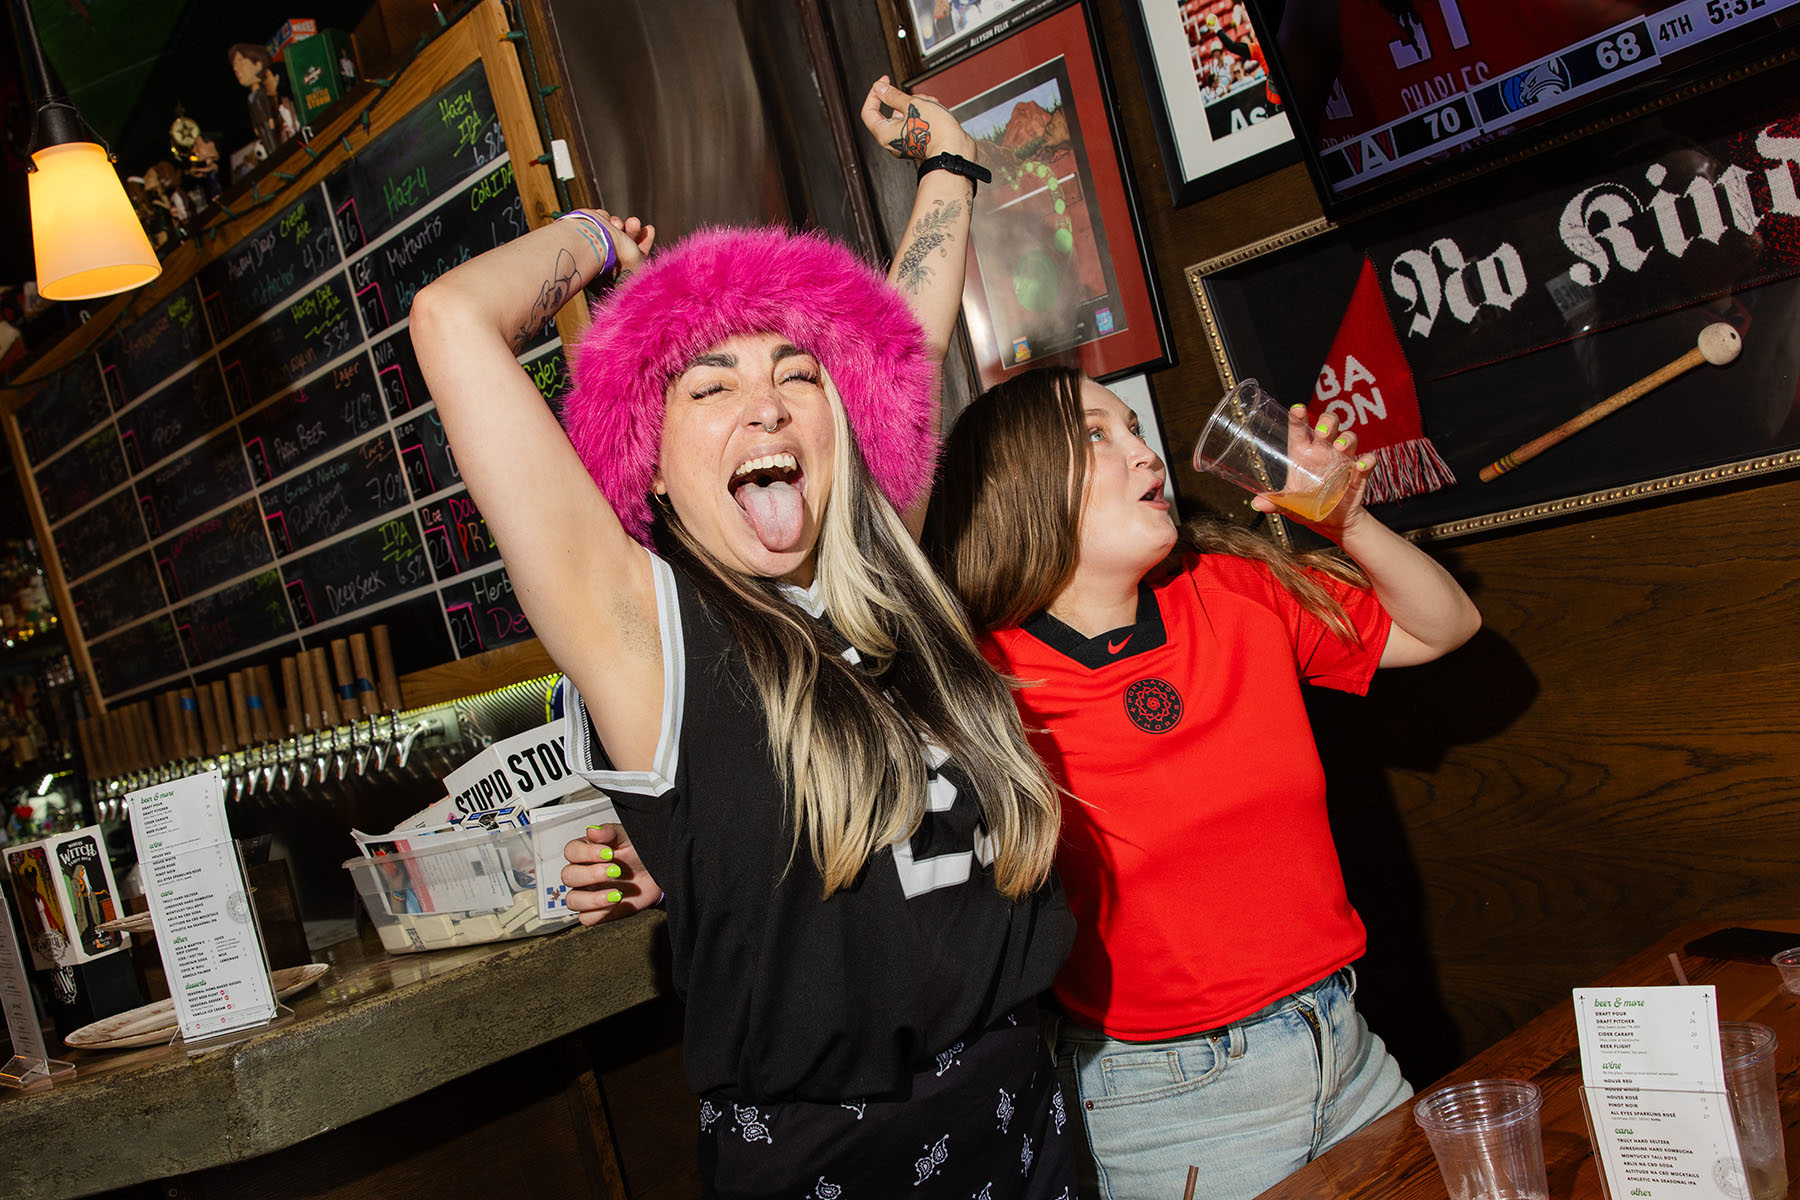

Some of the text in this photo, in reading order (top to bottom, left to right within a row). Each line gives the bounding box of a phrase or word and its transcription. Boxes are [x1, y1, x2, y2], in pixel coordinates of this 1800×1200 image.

[970, 20, 1009, 47] ALLYSON FELIX
[1659, 15, 1693, 41] 4TH
[1596, 32, 1641, 70] 68
[439, 90, 474, 128] Hazy
[1424, 107, 1460, 139] 70
[458, 110, 481, 144] IPA
[383, 166, 430, 219] Hazy
[471, 179, 491, 211] Cold
[280, 202, 306, 238] Cream
[338, 211, 359, 249] 16
[386, 215, 442, 277] Mutantis
[1390, 237, 1528, 338] No
[361, 297, 382, 336] 17
[375, 343, 394, 366] N/A
[332, 361, 360, 390] Lager
[1315, 355, 1376, 401] BA
[384, 380, 405, 411] 18
[408, 461, 424, 493] 19
[379, 520, 412, 551] IPA
[429, 536, 451, 569] 20
[472, 572, 513, 604] Herb
[451, 612, 475, 650] 21
[1128, 680, 1171, 703] PORTLAND
[1136, 704, 1180, 730] THORNS
[140, 796, 152, 804] beer
[455, 769, 512, 817] STUPID
[60, 844, 97, 865] WITCH
[1595, 999, 1611, 1007] beer
[1603, 1061, 1621, 1069] wine
[1631, 1188, 1652, 1196] other
